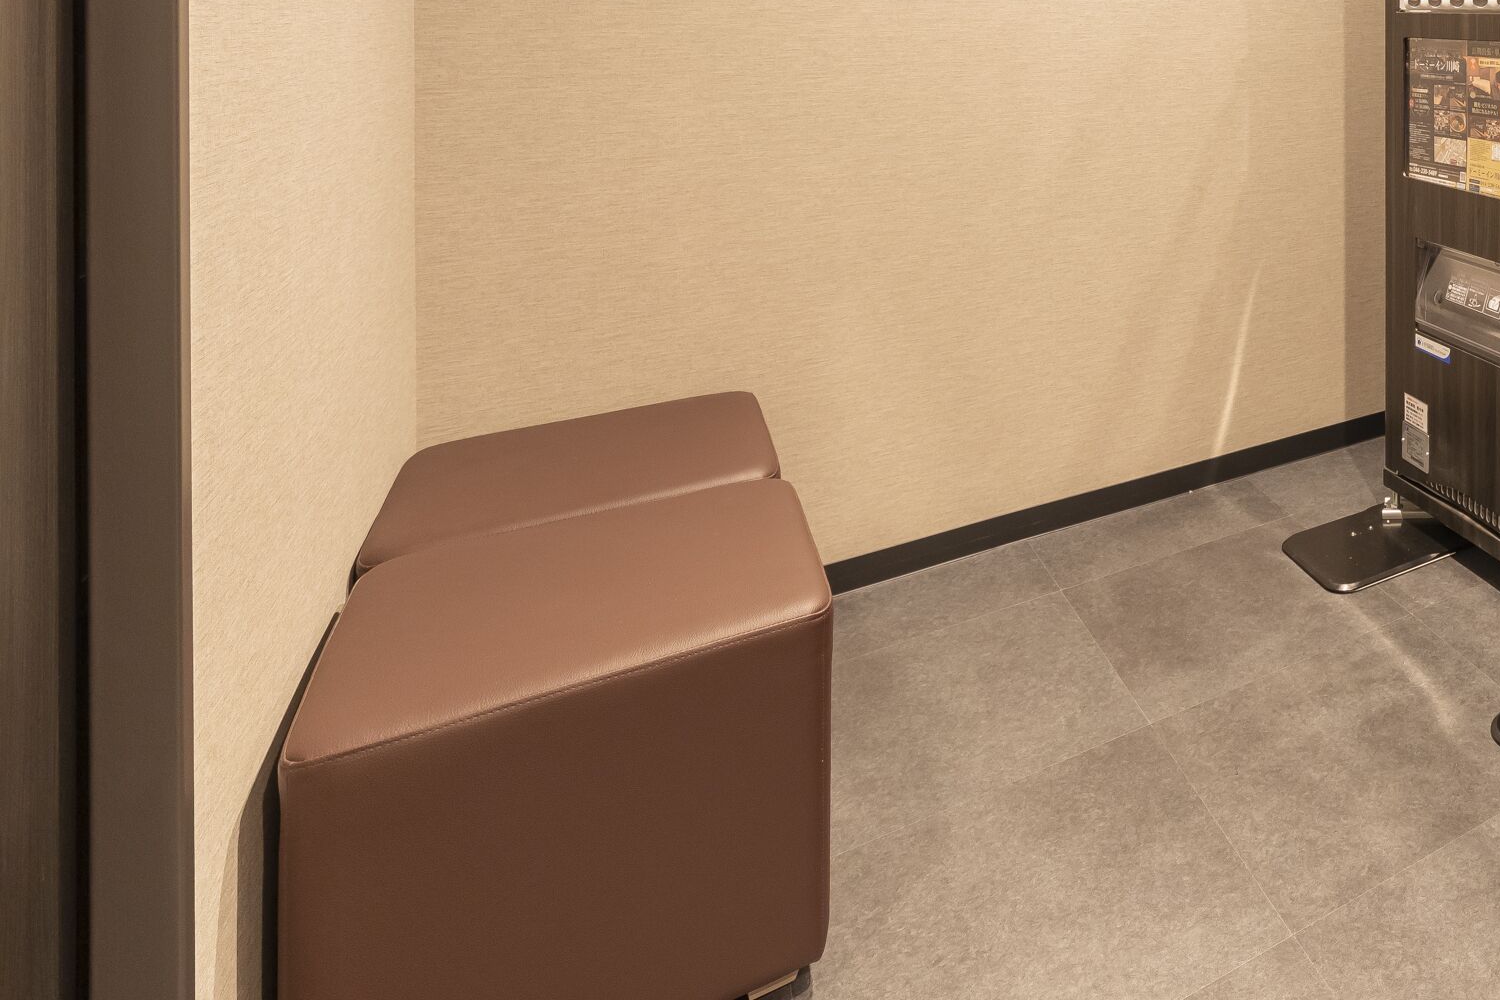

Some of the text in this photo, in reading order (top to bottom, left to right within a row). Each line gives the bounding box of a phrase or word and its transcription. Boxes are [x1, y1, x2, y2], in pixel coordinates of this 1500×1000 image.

[1414, 58, 1460, 73] ドーミーイン川崎
